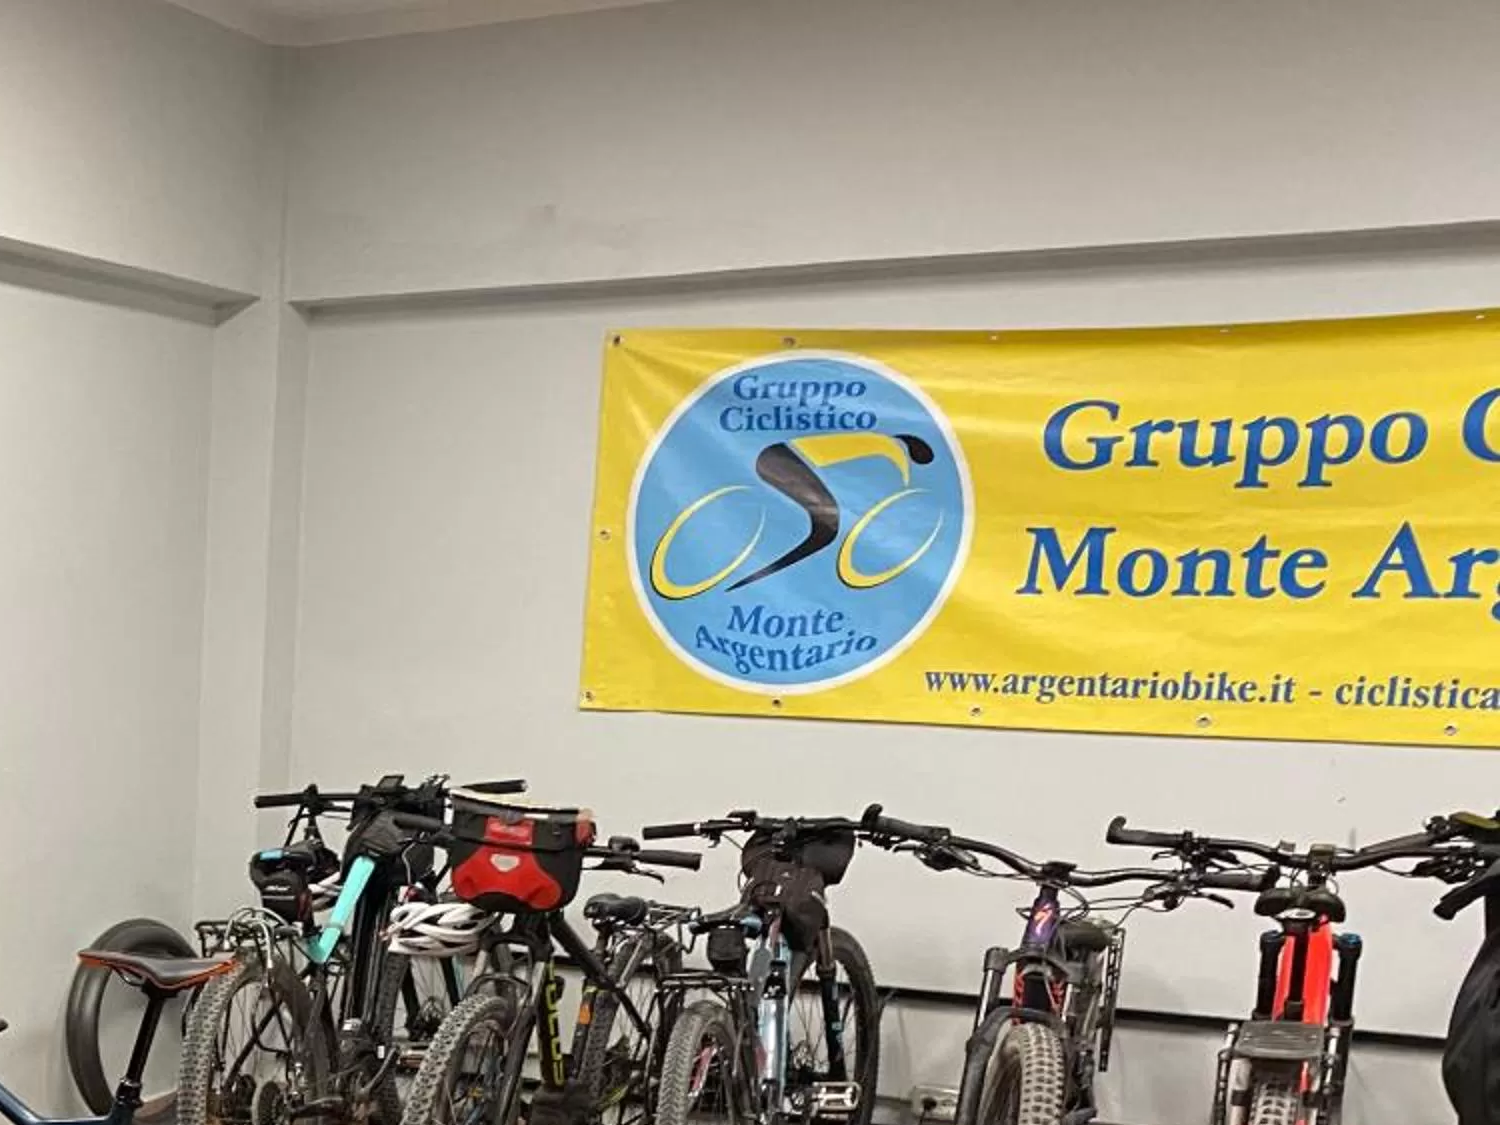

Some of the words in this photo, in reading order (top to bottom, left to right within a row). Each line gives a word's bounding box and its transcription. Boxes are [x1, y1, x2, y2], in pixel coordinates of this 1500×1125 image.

[733, 373, 867, 407] Gruppo
[719, 405, 878, 432] Ciclistico
[1042, 399, 1429, 489] Gruppo
[1015, 526, 1330, 600] Monte
[1351, 520, 1500, 622] Ar
[726, 604, 845, 639] Monte
[695, 623, 879, 675] Argentario
[924, 669, 1297, 704] www.argentariobike.it
